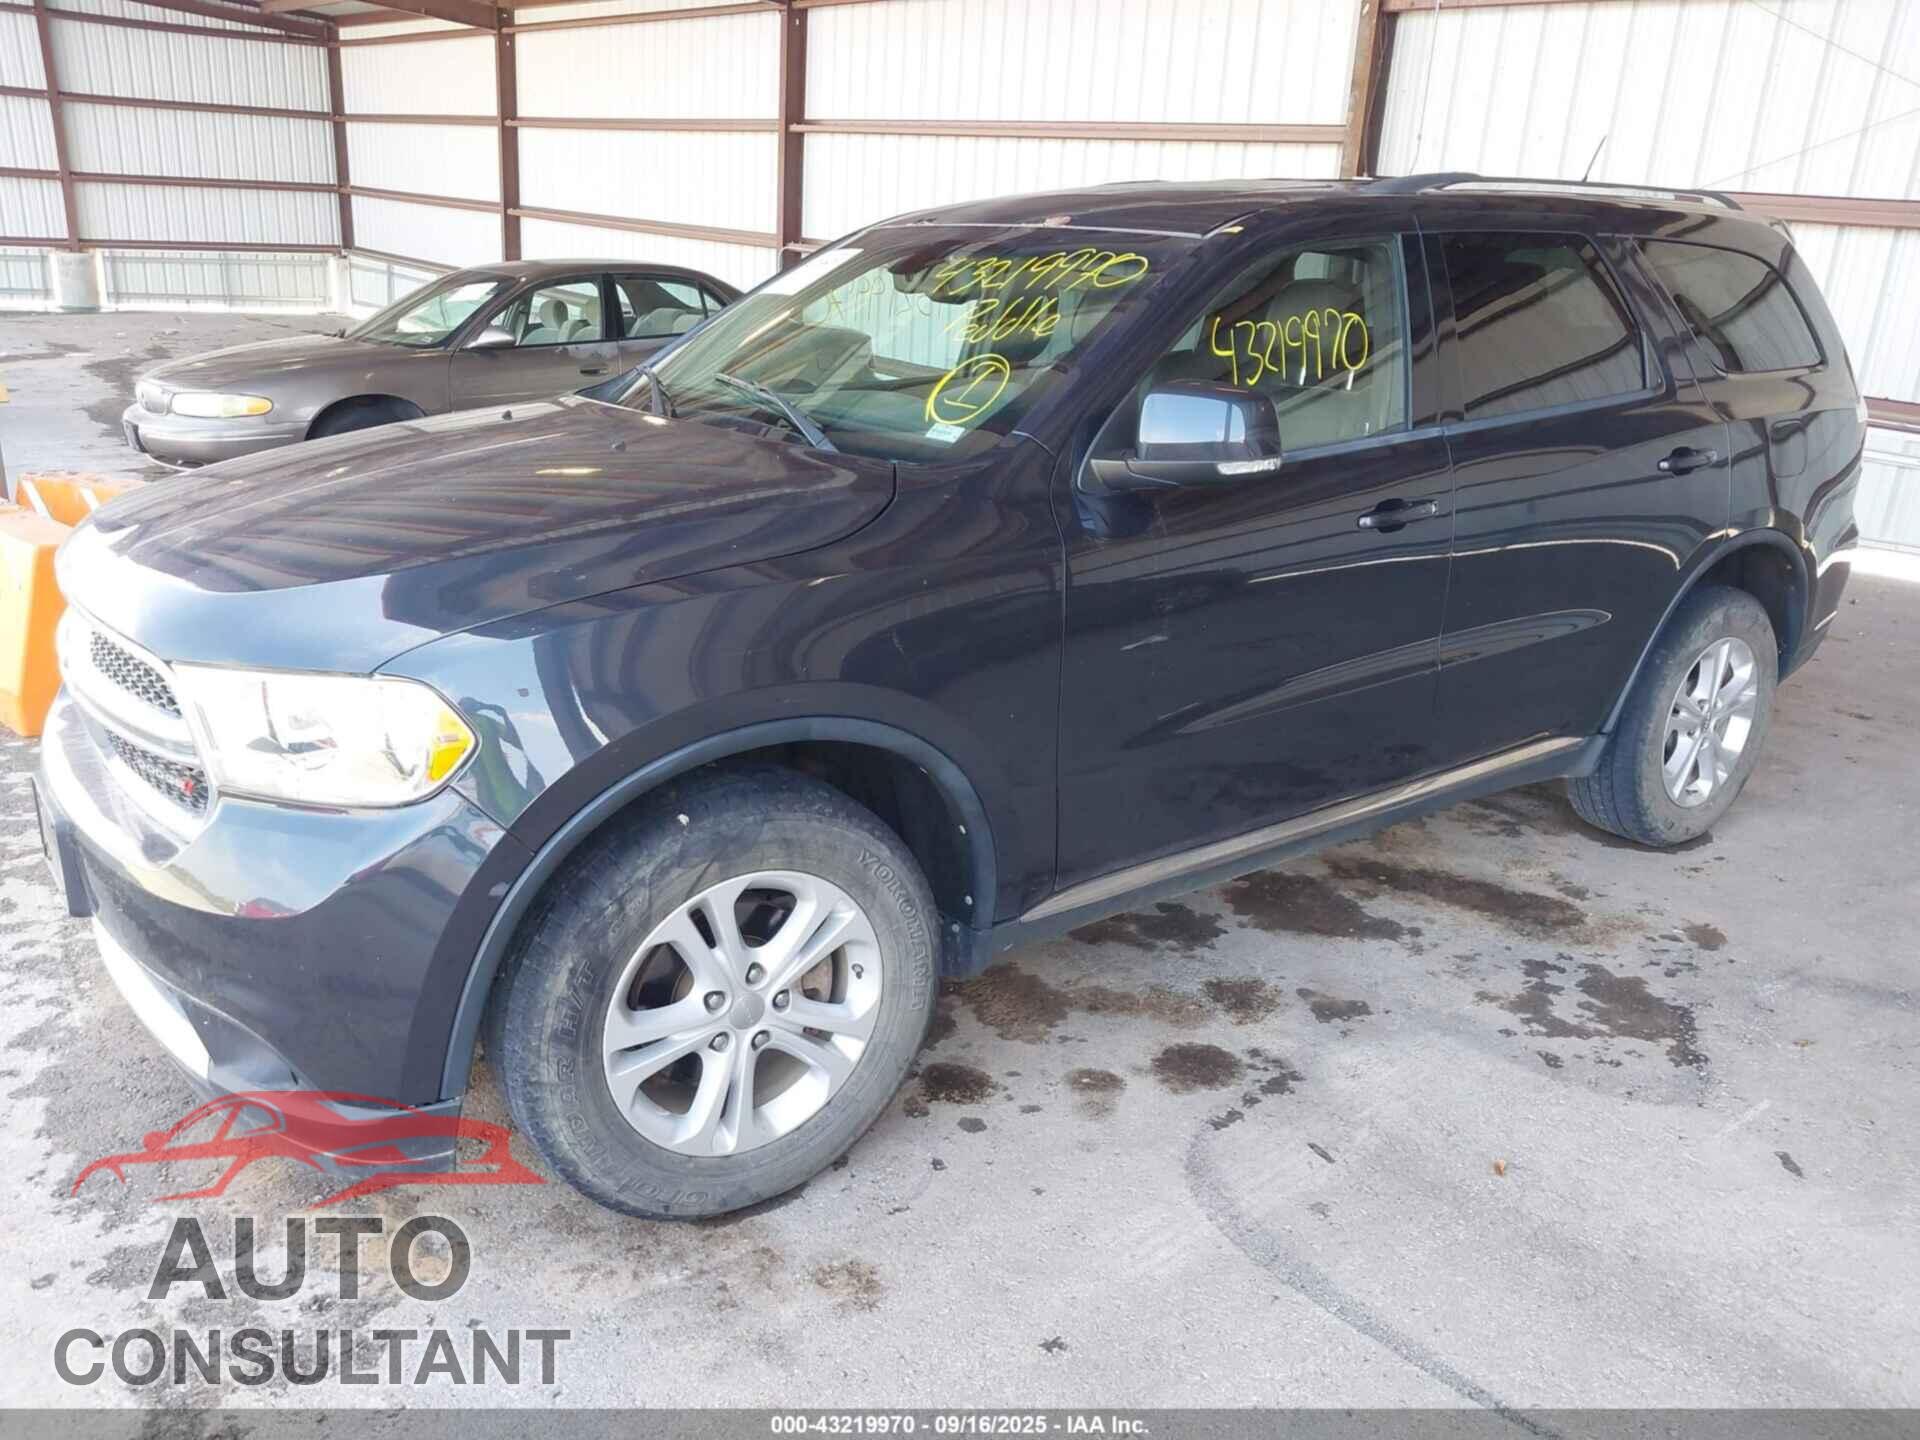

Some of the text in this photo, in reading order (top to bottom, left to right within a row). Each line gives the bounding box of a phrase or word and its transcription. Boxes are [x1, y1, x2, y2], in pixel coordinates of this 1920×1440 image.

[932, 248, 1149, 296] 43219970
[1212, 307, 1369, 391] 43219970
[857, 848, 930, 1010] YOKOHAMA
